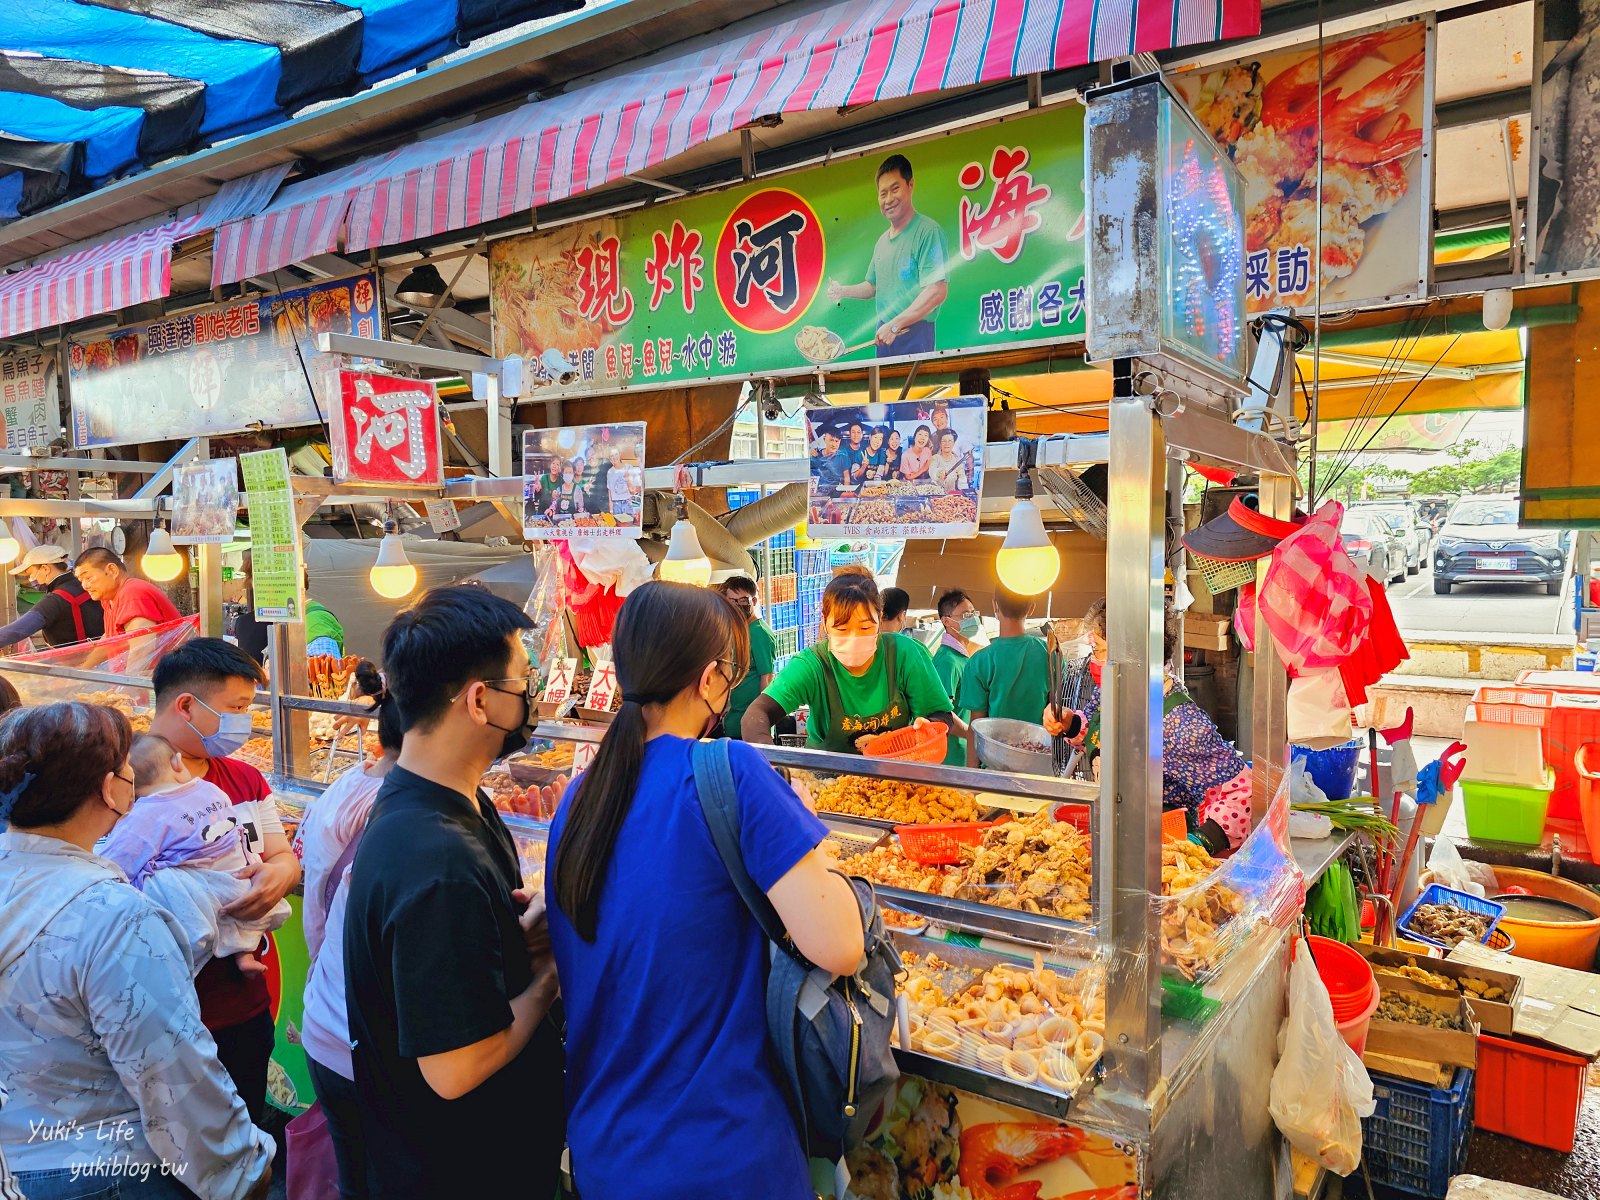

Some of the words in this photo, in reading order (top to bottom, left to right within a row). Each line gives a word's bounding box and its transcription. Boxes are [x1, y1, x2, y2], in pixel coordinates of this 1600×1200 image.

[576, 219, 703, 326] 現炸
[730, 210, 808, 314] 河
[1245, 245, 1309, 301] 採訪
[147, 303, 260, 355] 興達港創始老店
[2, 353, 44, 382] 烏魚子
[350, 380, 432, 480] 河
[843, 525, 861, 535] TVBS
